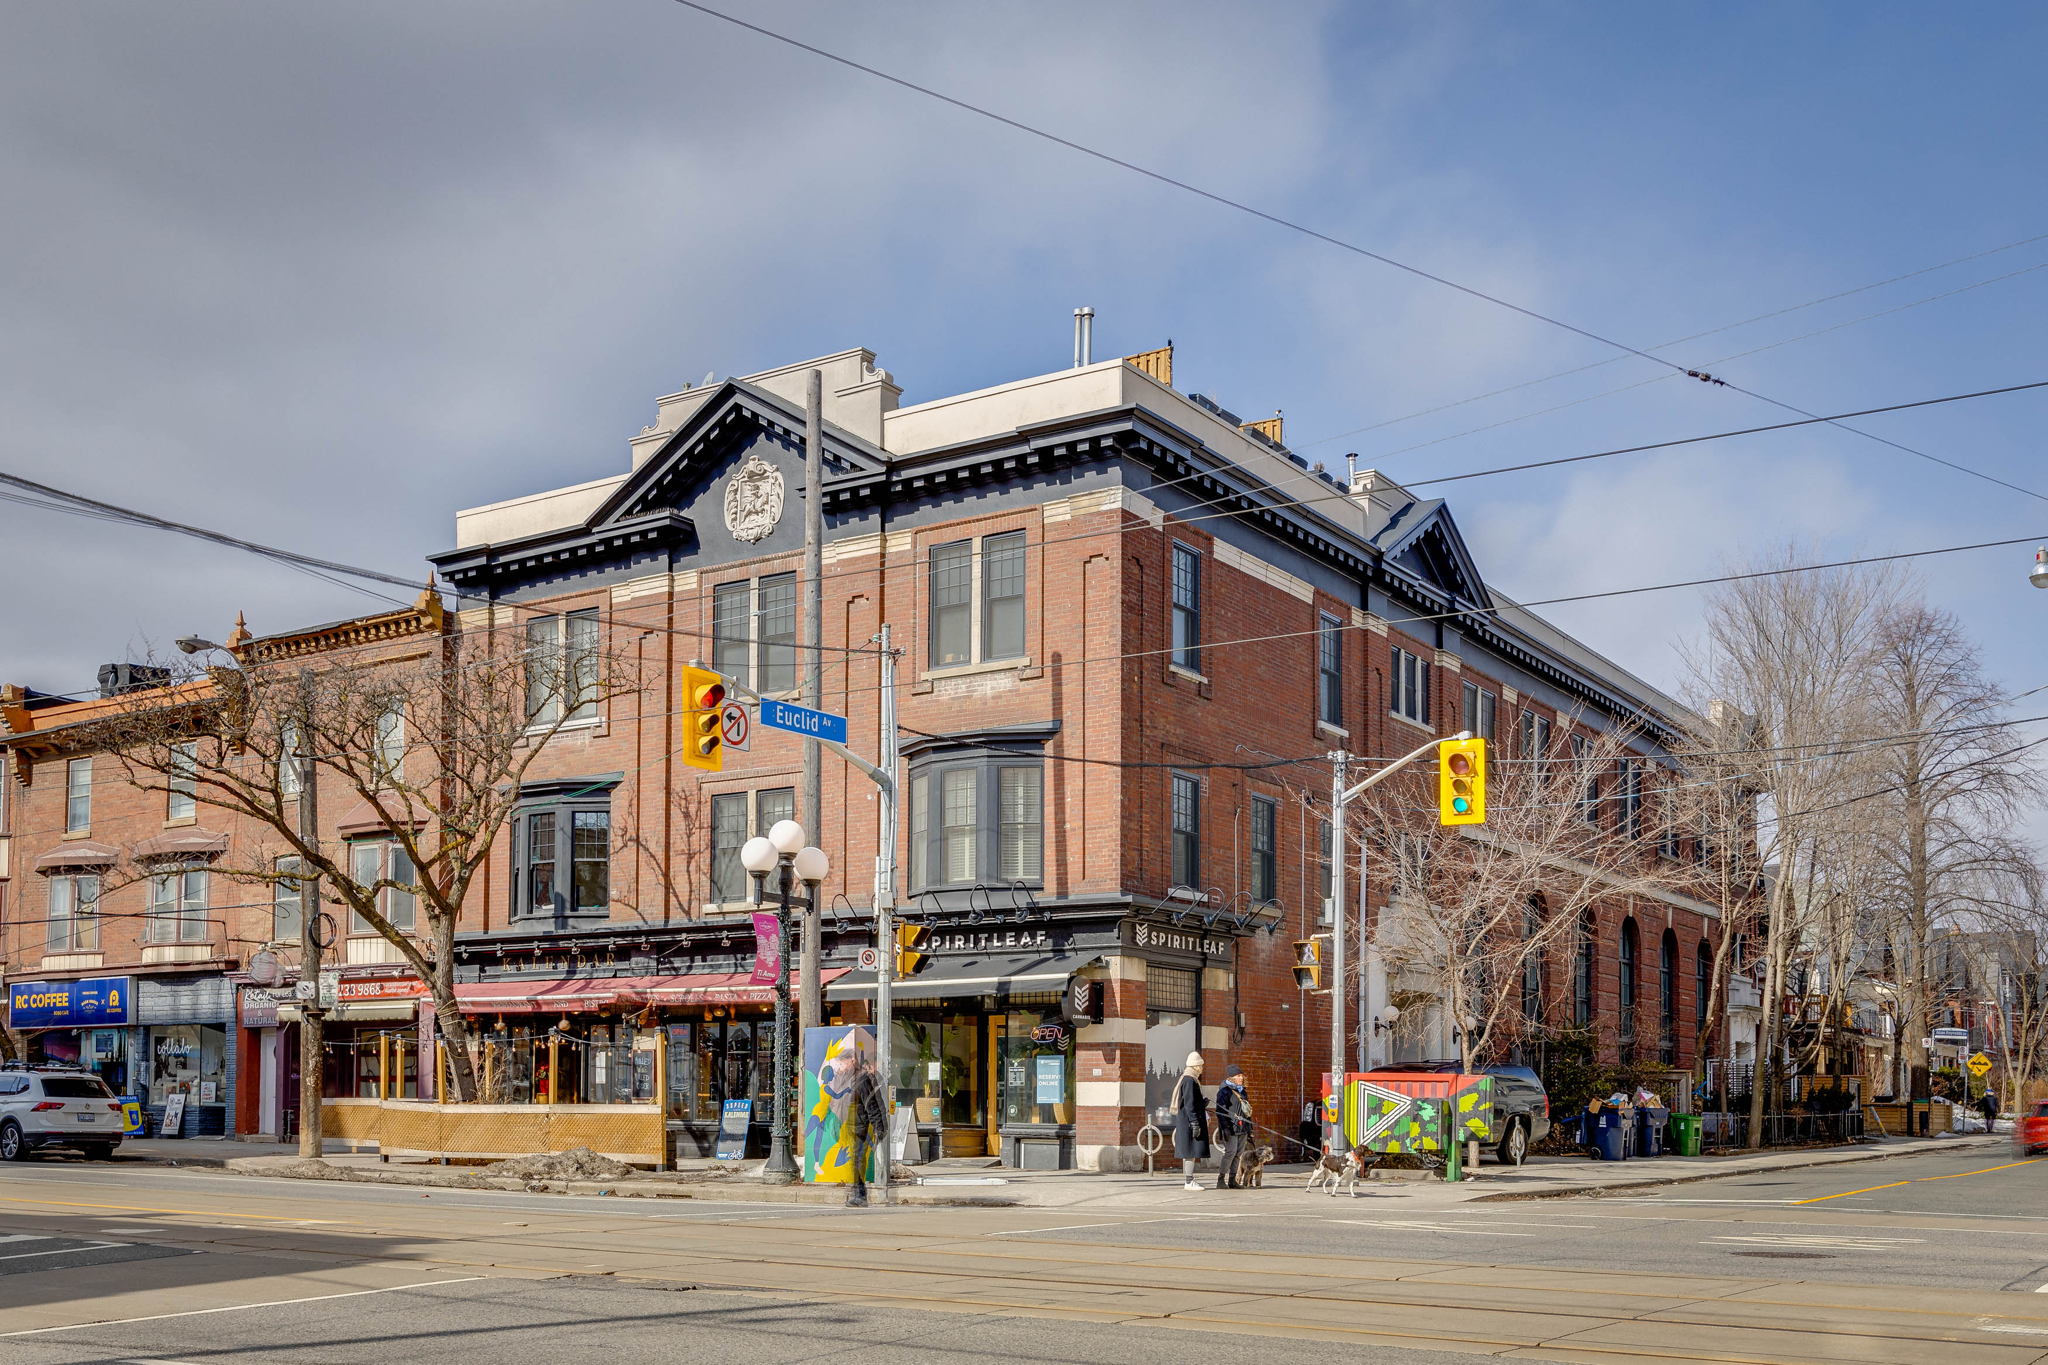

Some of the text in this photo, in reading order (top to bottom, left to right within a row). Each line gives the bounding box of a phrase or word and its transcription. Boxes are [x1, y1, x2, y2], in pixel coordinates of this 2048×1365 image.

[776, 705, 832, 732] Euclid Av
[1150, 931, 1225, 955] SPIRITLEAF
[502, 952, 616, 971] KALENDAR
[15, 994, 28, 1008] RC
[30, 992, 69, 1008] COFFEE
[749, 993, 772, 1001] PIZZA
[243, 1017, 276, 1025] NATURAL
[1031, 1027, 1063, 1040] OPEN
